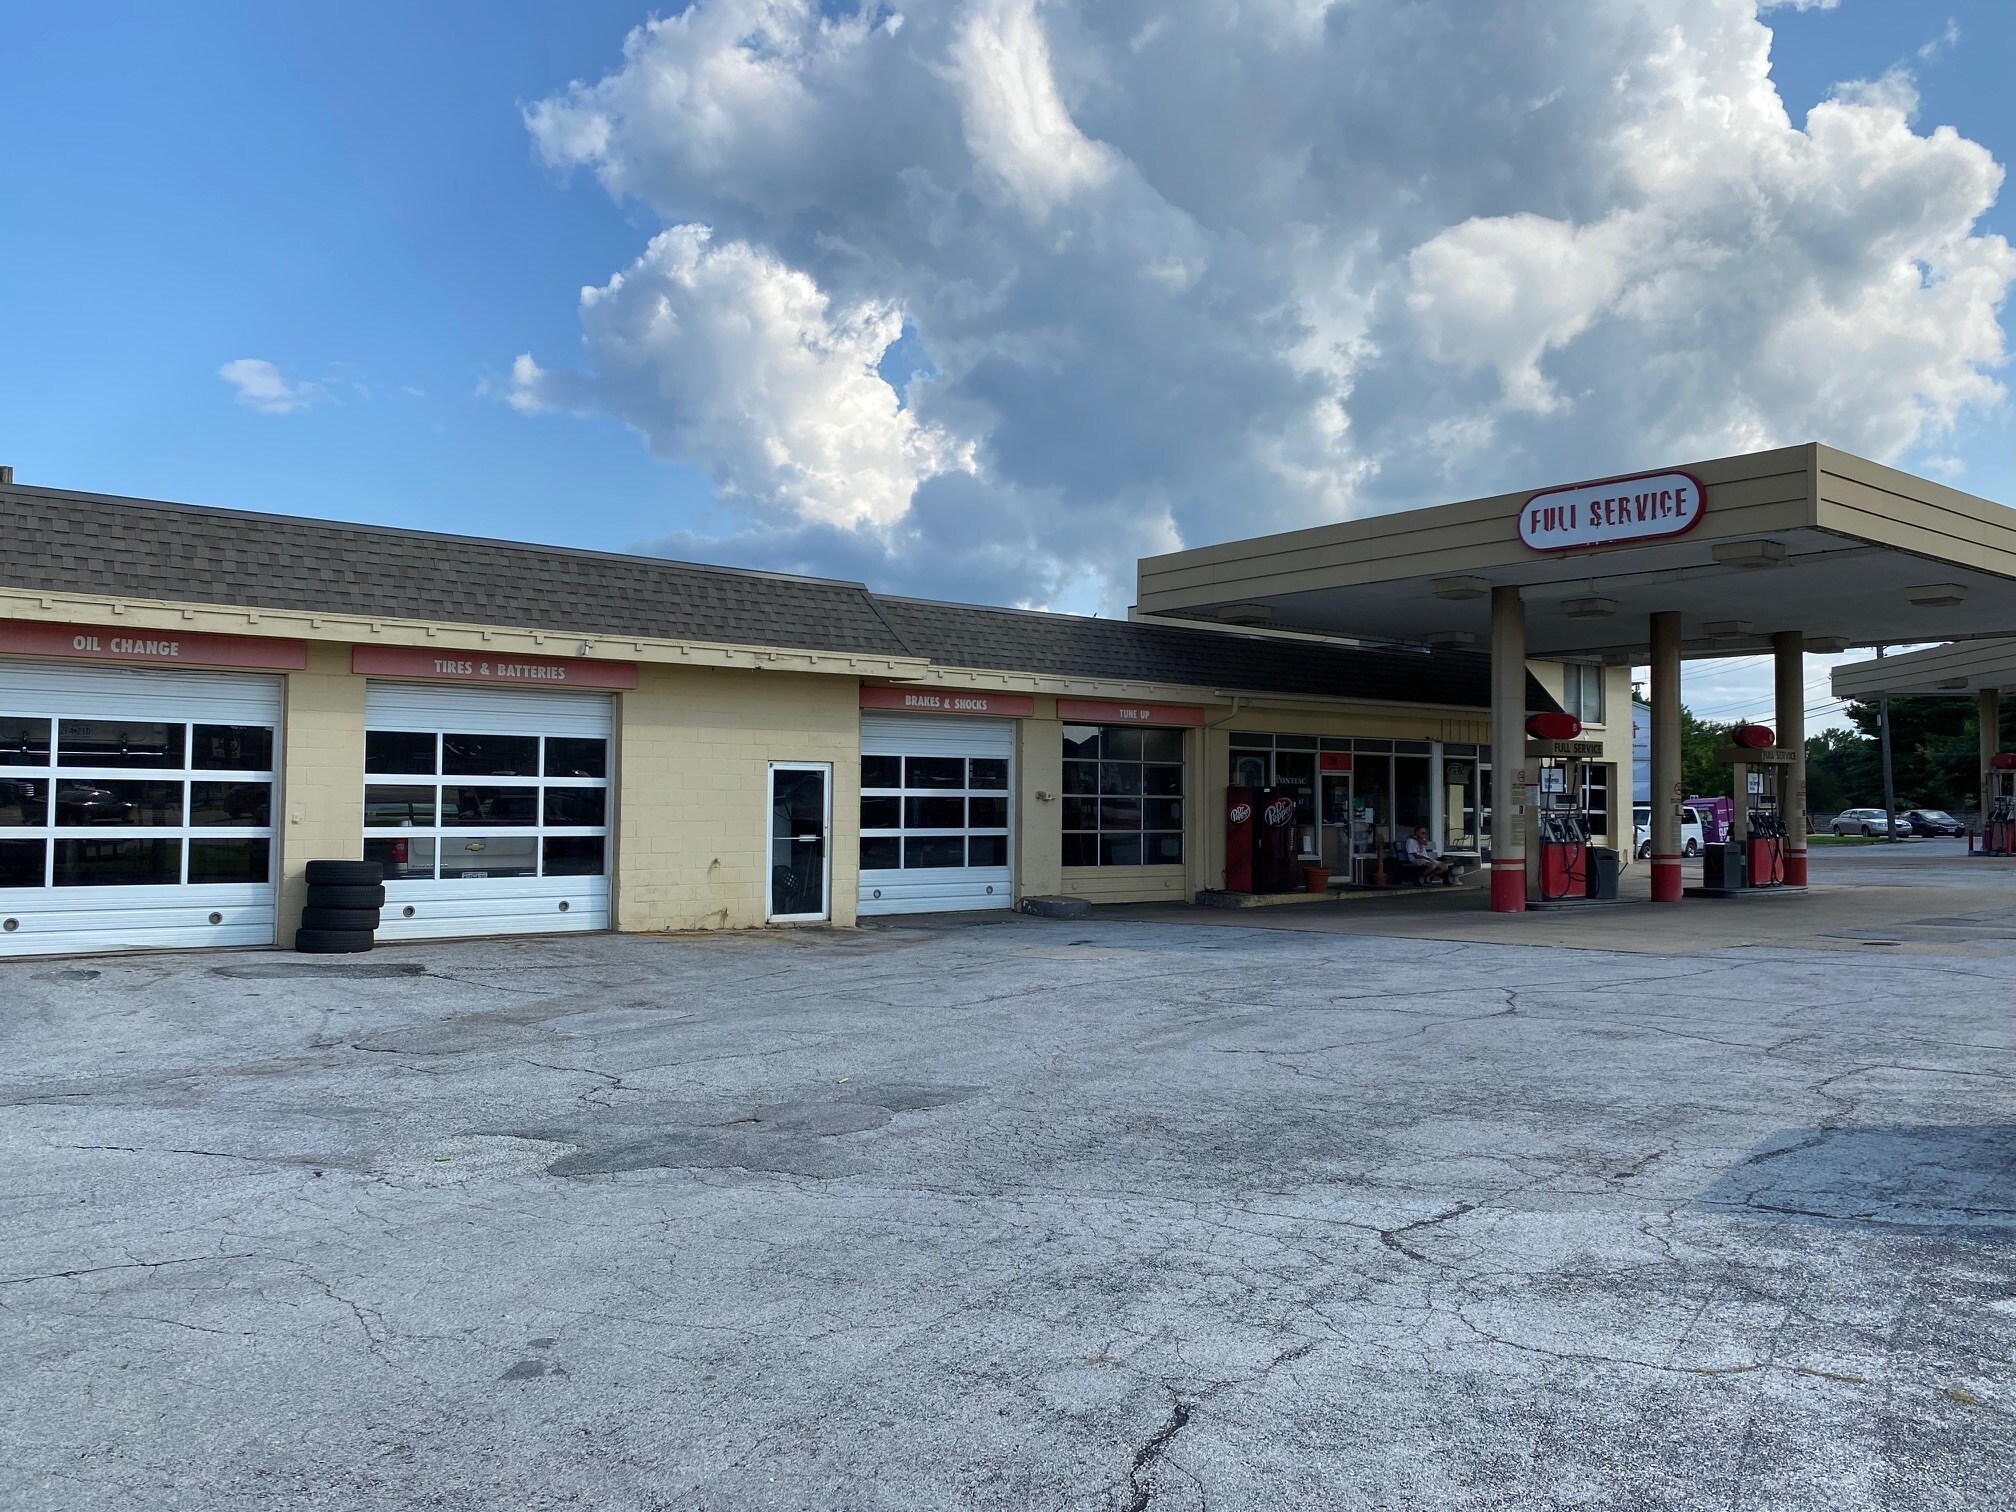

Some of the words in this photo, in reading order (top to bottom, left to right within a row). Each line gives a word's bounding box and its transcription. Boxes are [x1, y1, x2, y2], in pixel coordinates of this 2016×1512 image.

[1589, 487, 1687, 529] SERVICE
[73, 635, 101, 651] OIL
[110, 638, 179, 656] CHANGE
[434, 660, 473, 675] TIRES
[480, 663, 490, 675] &
[497, 663, 566, 680] BATTERIES
[905, 695, 940, 707] BRAKES
[943, 698, 951, 709] &
[954, 698, 988, 711] SHOCKS
[1119, 709, 1138, 719] TUNE
[1140, 710, 1150, 719] UP
[1554, 743, 1571, 753] FULL
[1573, 743, 1602, 754] SERVICE
[1268, 805, 1292, 826] Pepper
[1275, 801, 1287, 813] Dr
